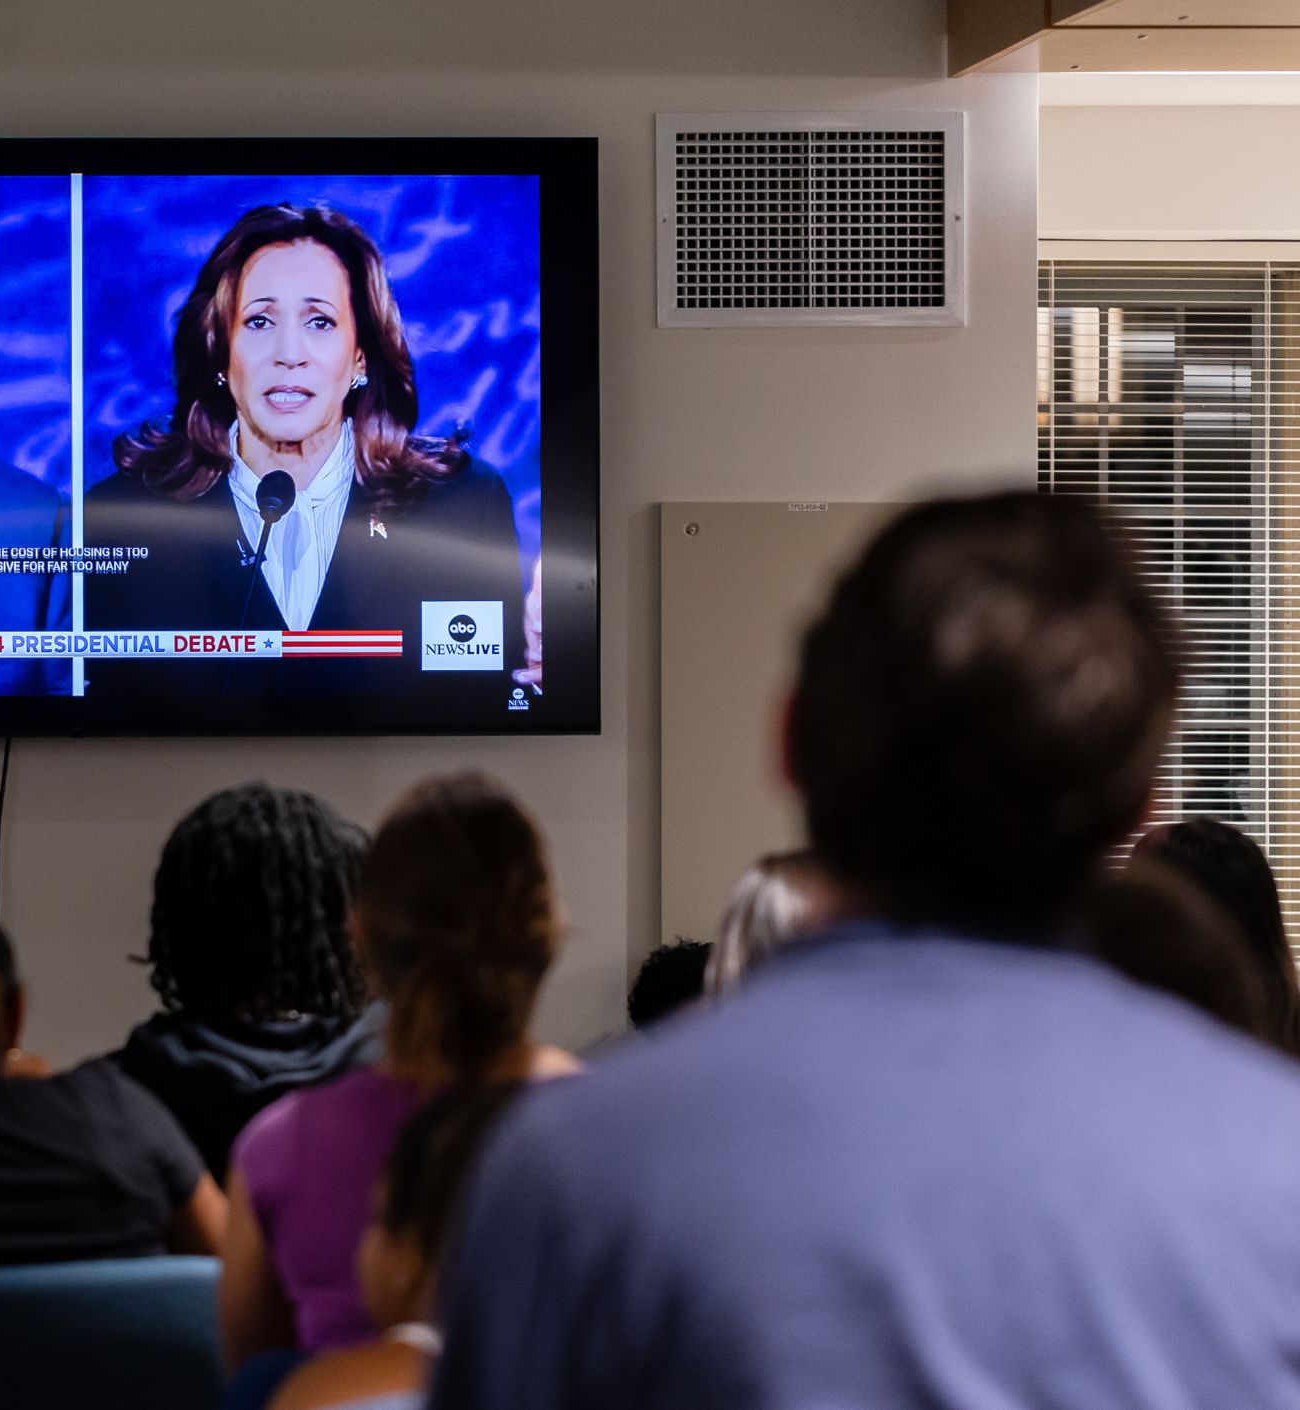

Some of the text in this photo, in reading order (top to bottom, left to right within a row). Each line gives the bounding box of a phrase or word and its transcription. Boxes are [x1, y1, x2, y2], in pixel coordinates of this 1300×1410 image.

[10, 547, 40, 559] COST
[42, 547, 58, 559] OF
[59, 547, 110, 559] HOUSING
[112, 547, 124, 559] IS
[125, 547, 149, 559] TOO
[23, 561, 45, 574] FOR
[47, 561, 68, 574] FAR
[70, 561, 93, 574] TOO
[95, 561, 130, 574] MANY
[449, 622, 475, 634] abc
[12, 635, 165, 653] PRESIDENTIAL
[174, 635, 257, 652] DEBATE
[425, 644, 500, 656] NEWS LIVE
